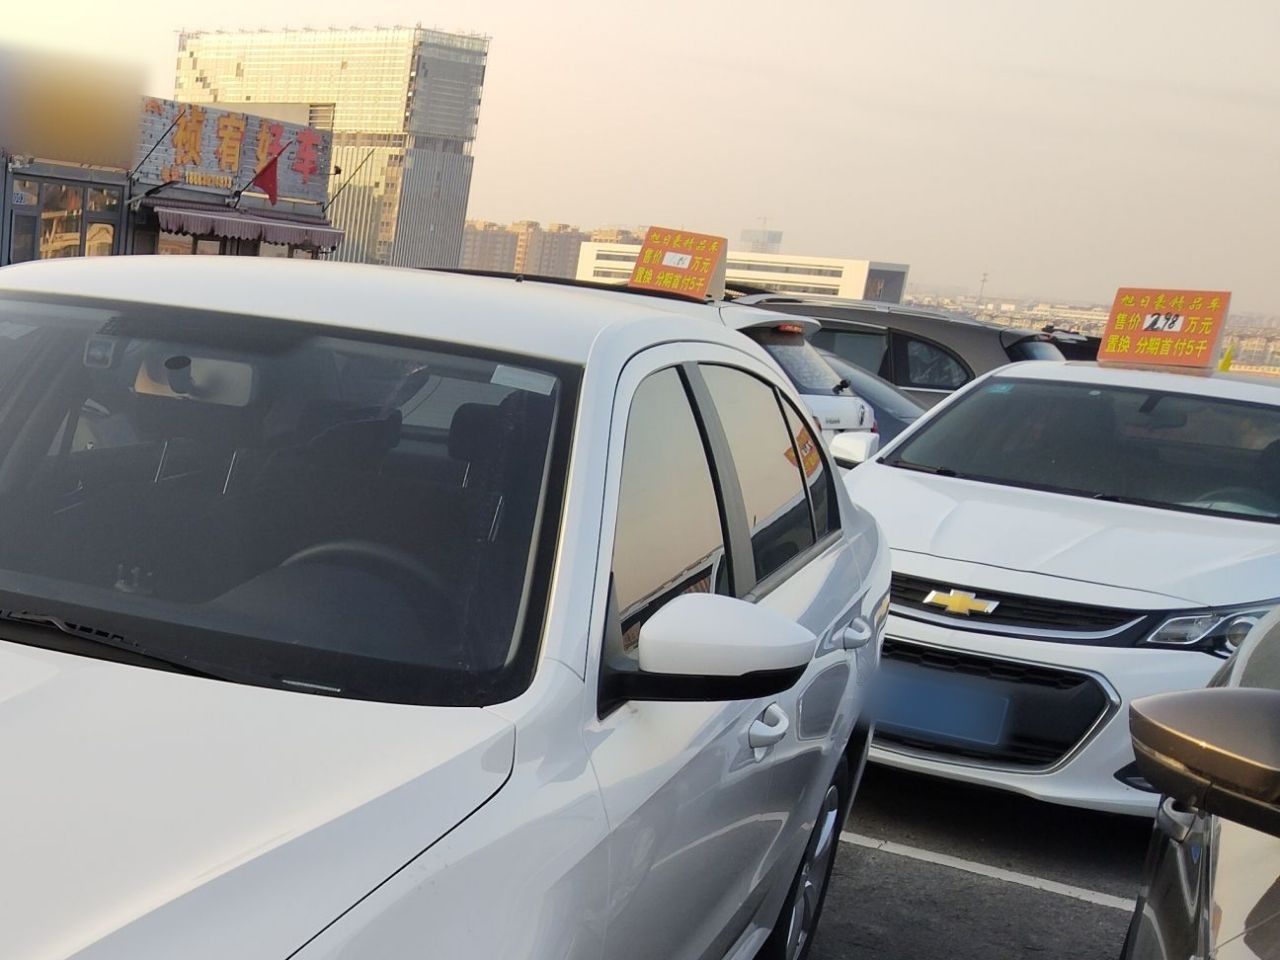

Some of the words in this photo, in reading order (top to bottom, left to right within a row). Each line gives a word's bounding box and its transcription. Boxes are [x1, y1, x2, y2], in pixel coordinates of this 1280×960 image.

[691, 256, 711, 273] 万元
[1114, 312, 1141, 330] 售价
[1184, 316, 1213, 334] 万元
[1106, 334, 1131, 353] 置换
[1135, 336, 1208, 358] 分期首付5千
